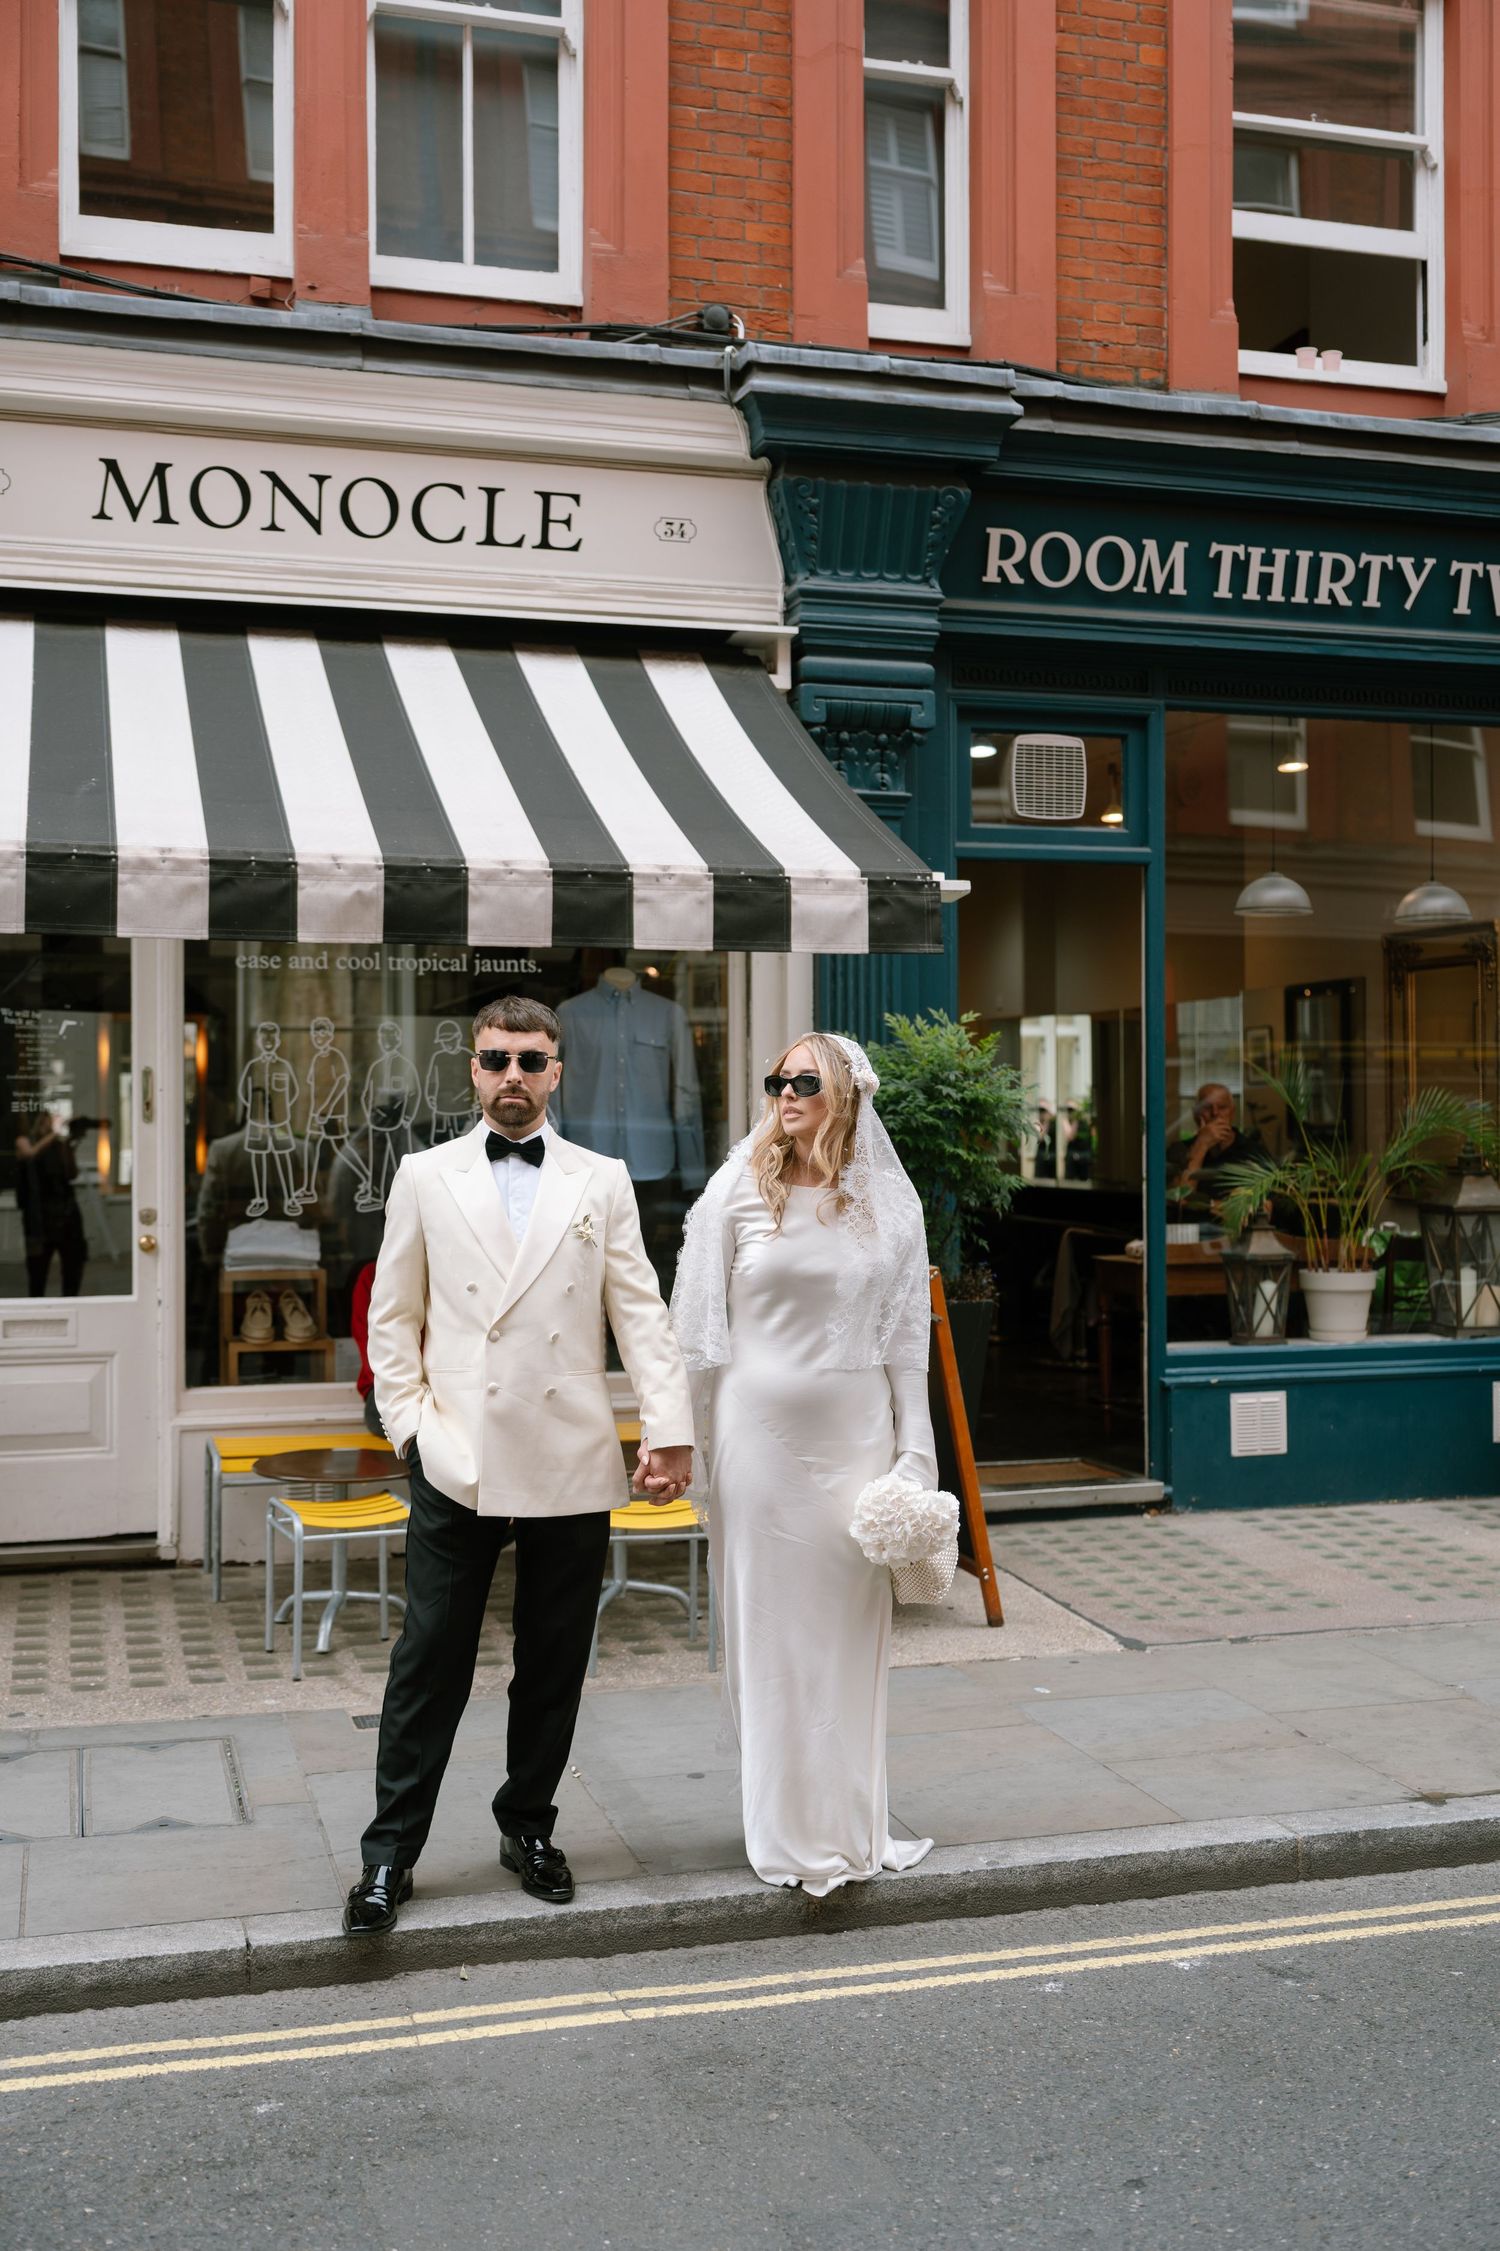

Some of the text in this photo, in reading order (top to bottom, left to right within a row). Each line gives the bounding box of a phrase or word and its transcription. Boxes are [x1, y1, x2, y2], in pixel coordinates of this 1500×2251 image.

[92, 458, 583, 552] MONOCLE
[664, 521, 686, 539] 34
[982, 527, 1189, 596] ROOM
[1208, 541, 1437, 611] THIRTY
[235, 951, 543, 976] ease and cool tropical jaunts.
